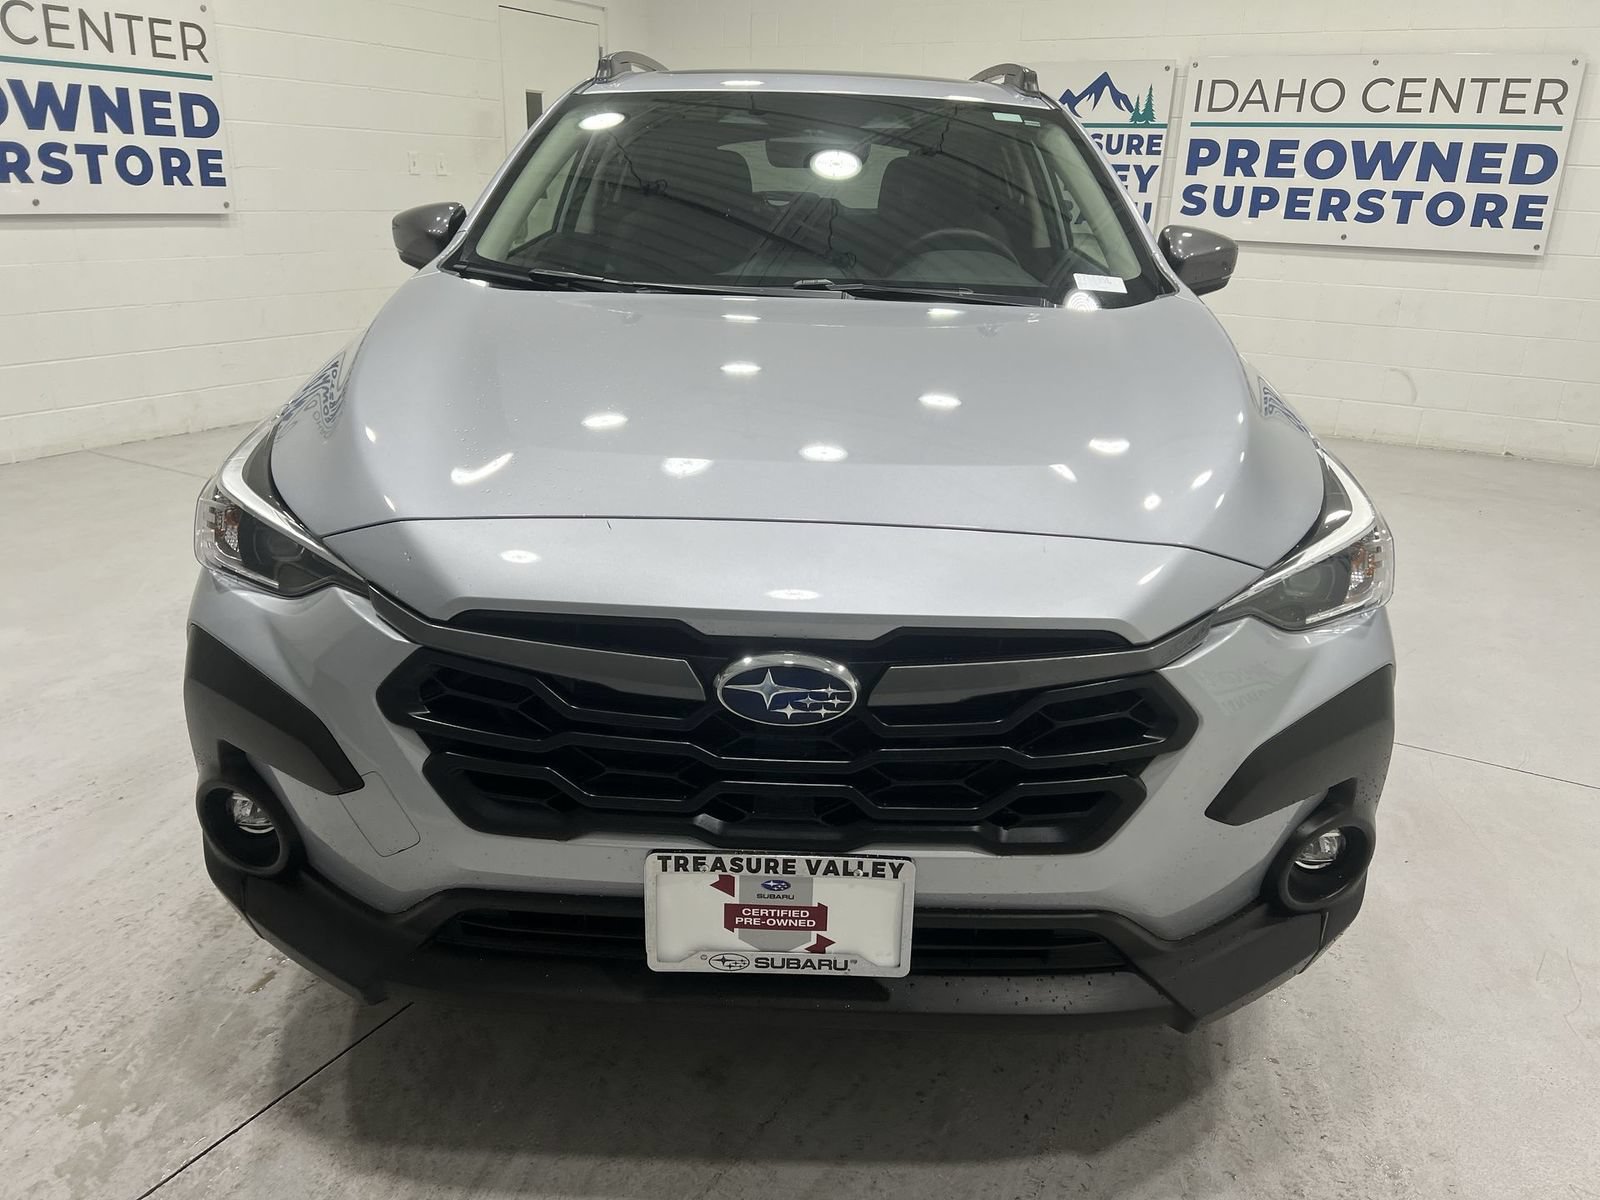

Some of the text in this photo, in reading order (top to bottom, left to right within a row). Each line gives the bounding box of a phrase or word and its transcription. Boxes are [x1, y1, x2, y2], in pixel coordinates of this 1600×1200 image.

[0, 0, 209, 63] CENTER
[0, 78, 220, 139] WNED
[1193, 77, 1569, 116] IDAHO CENTER
[1185, 138, 1558, 186] PREOWNED
[1180, 184, 1550, 231] SUPERSTORE
[657, 855, 905, 879] TREASURE VALLEY
[735, 917, 816, 927] PRE-OWNED
[742, 908, 810, 918] CERTIFIED
[754, 957, 849, 971] SUBARU
